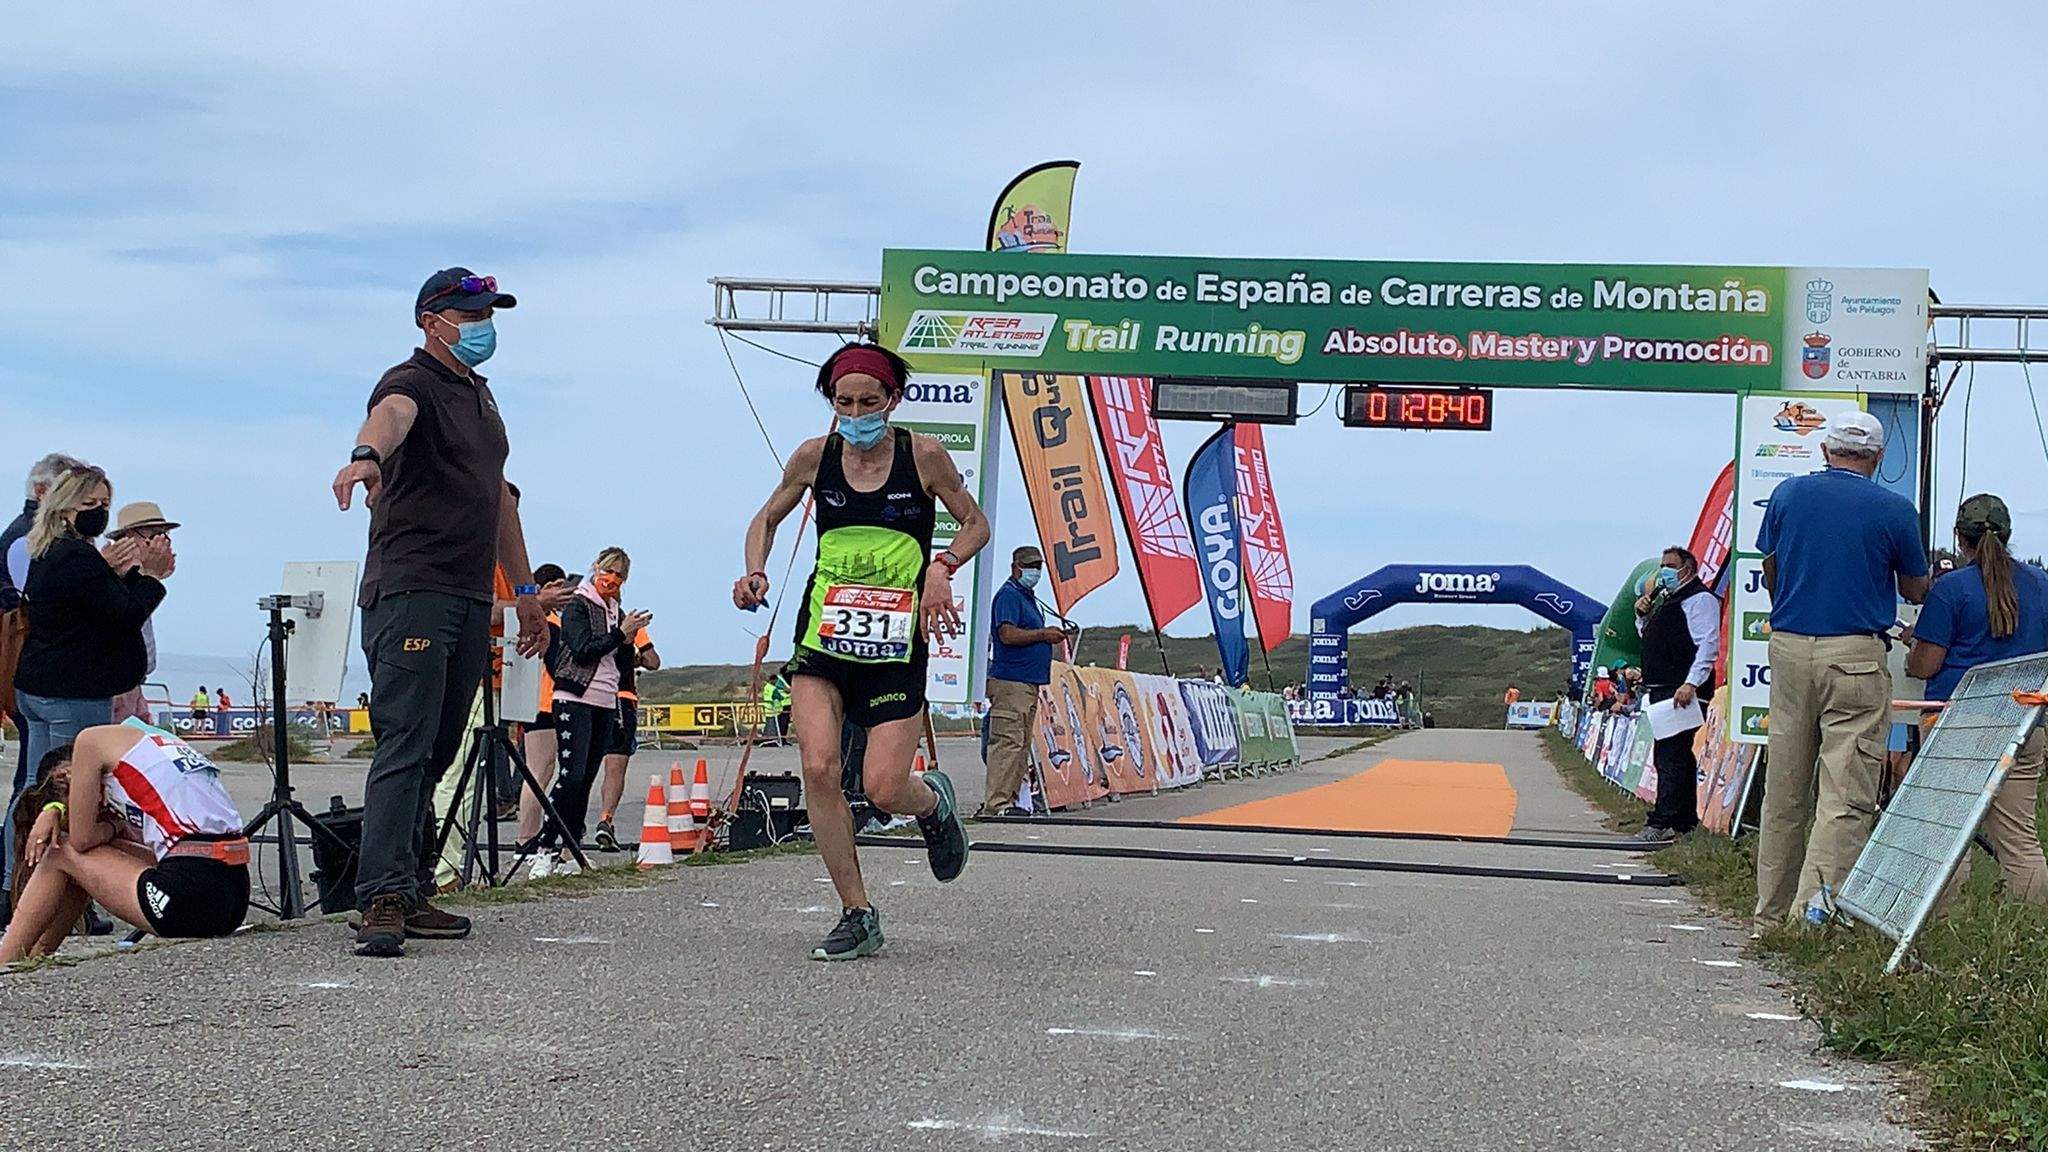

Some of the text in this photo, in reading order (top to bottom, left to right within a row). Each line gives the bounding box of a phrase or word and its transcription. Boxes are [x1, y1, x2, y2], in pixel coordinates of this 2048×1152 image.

[913, 265, 1768, 314] Campeonato de España de Carreras de Montaña
[1841, 296, 1902, 306] Ayuntamiento
[1846, 305, 1857, 314] de
[963, 326, 1045, 341] ATLETISMO
[968, 317, 1022, 330] RFEA
[959, 341, 1040, 351] TRAIL RUNNING
[1064, 319, 1306, 364] Trail Running
[1323, 329, 1769, 364] Absoluto, Master y Promoción
[1837, 347, 1902, 359] GOBIERNO
[1837, 360, 1850, 368] de
[1836, 369, 1907, 381] CANTABRIA
[903, 383, 973, 404] oma
[1100, 376, 1152, 482] RFE
[1251, 448, 1282, 549] ATLETISMO
[1050, 465, 1101, 583] Trail
[1200, 504, 1240, 620] GOYA
[1415, 572, 1496, 594] Joma
[834, 608, 891, 640] 331
[403, 638, 432, 651] ESP
[1353, 697, 1397, 722] Joma
